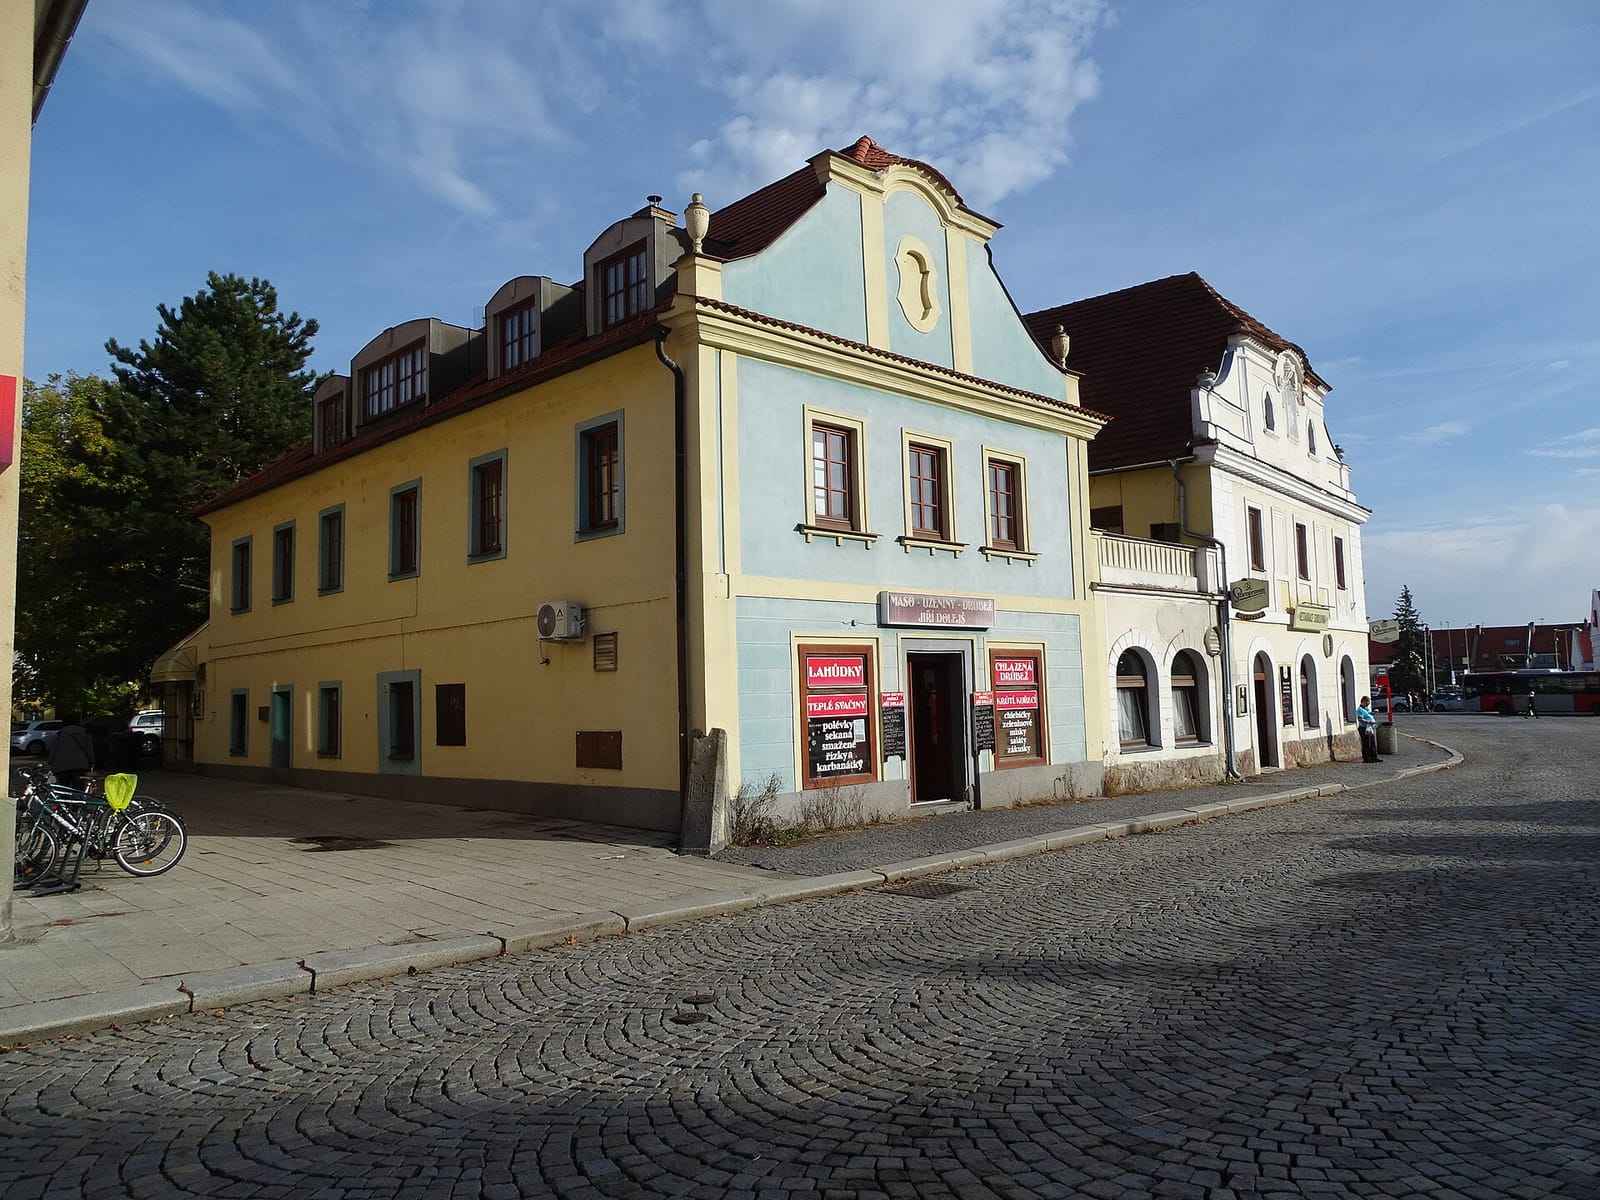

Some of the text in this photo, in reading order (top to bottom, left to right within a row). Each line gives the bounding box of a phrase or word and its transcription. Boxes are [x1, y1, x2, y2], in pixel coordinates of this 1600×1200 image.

[890, 595, 915, 608] MASO
[808, 663, 862, 678] LAHŮDKY
[808, 699, 866, 711] TEPLÉ SVAČINY
[822, 720, 853, 732] polévky
[825, 731, 853, 740] sekaná
[822, 741, 857, 750] smažené
[825, 751, 848, 761] řízky
[816, 759, 864, 772] karbanátky
